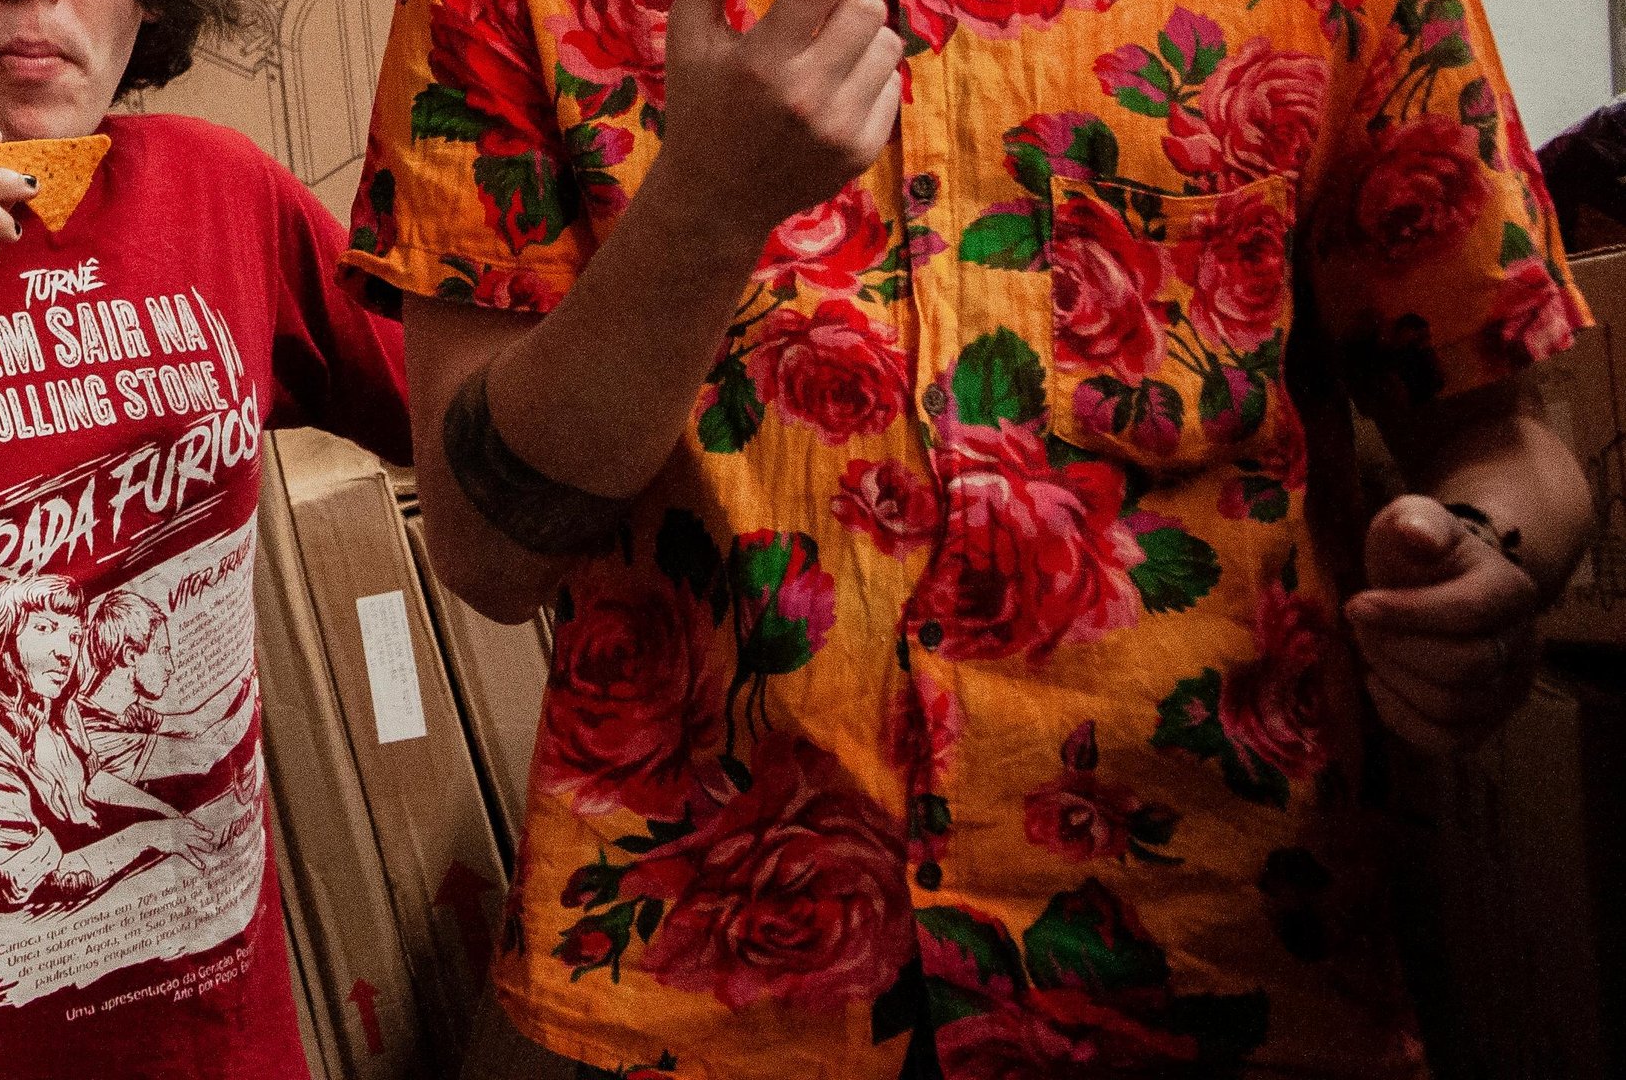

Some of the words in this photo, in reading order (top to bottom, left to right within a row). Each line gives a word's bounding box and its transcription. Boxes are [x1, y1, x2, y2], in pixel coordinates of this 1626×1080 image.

[20, 258, 105, 308] TURNÊ
[45, 298, 150, 369] SAIR
[147, 293, 209, 354] NA
[116, 360, 228, 421] STONE
[168, 566, 214, 613] VITOR
[45, 923, 115, 954] sobrevivente
[120, 916, 135, 928] do
[46, 926, 68, 940] que
[73, 911, 110, 931] consta
[115, 903, 132, 917] em
[18, 967, 33, 978] de
[85, 937, 120, 956] Agora,
[124, 928, 141, 941] em
[35, 959, 99, 989] paulistanos
[104, 937, 152, 963] enquanto
[66, 1003, 95, 1021] Uma
[101, 977, 180, 1012] apresentação
[182, 971, 196, 984] da
[198, 957, 234, 978] Geração
[174, 987, 194, 1003] Arte
[198, 980, 214, 996] por
